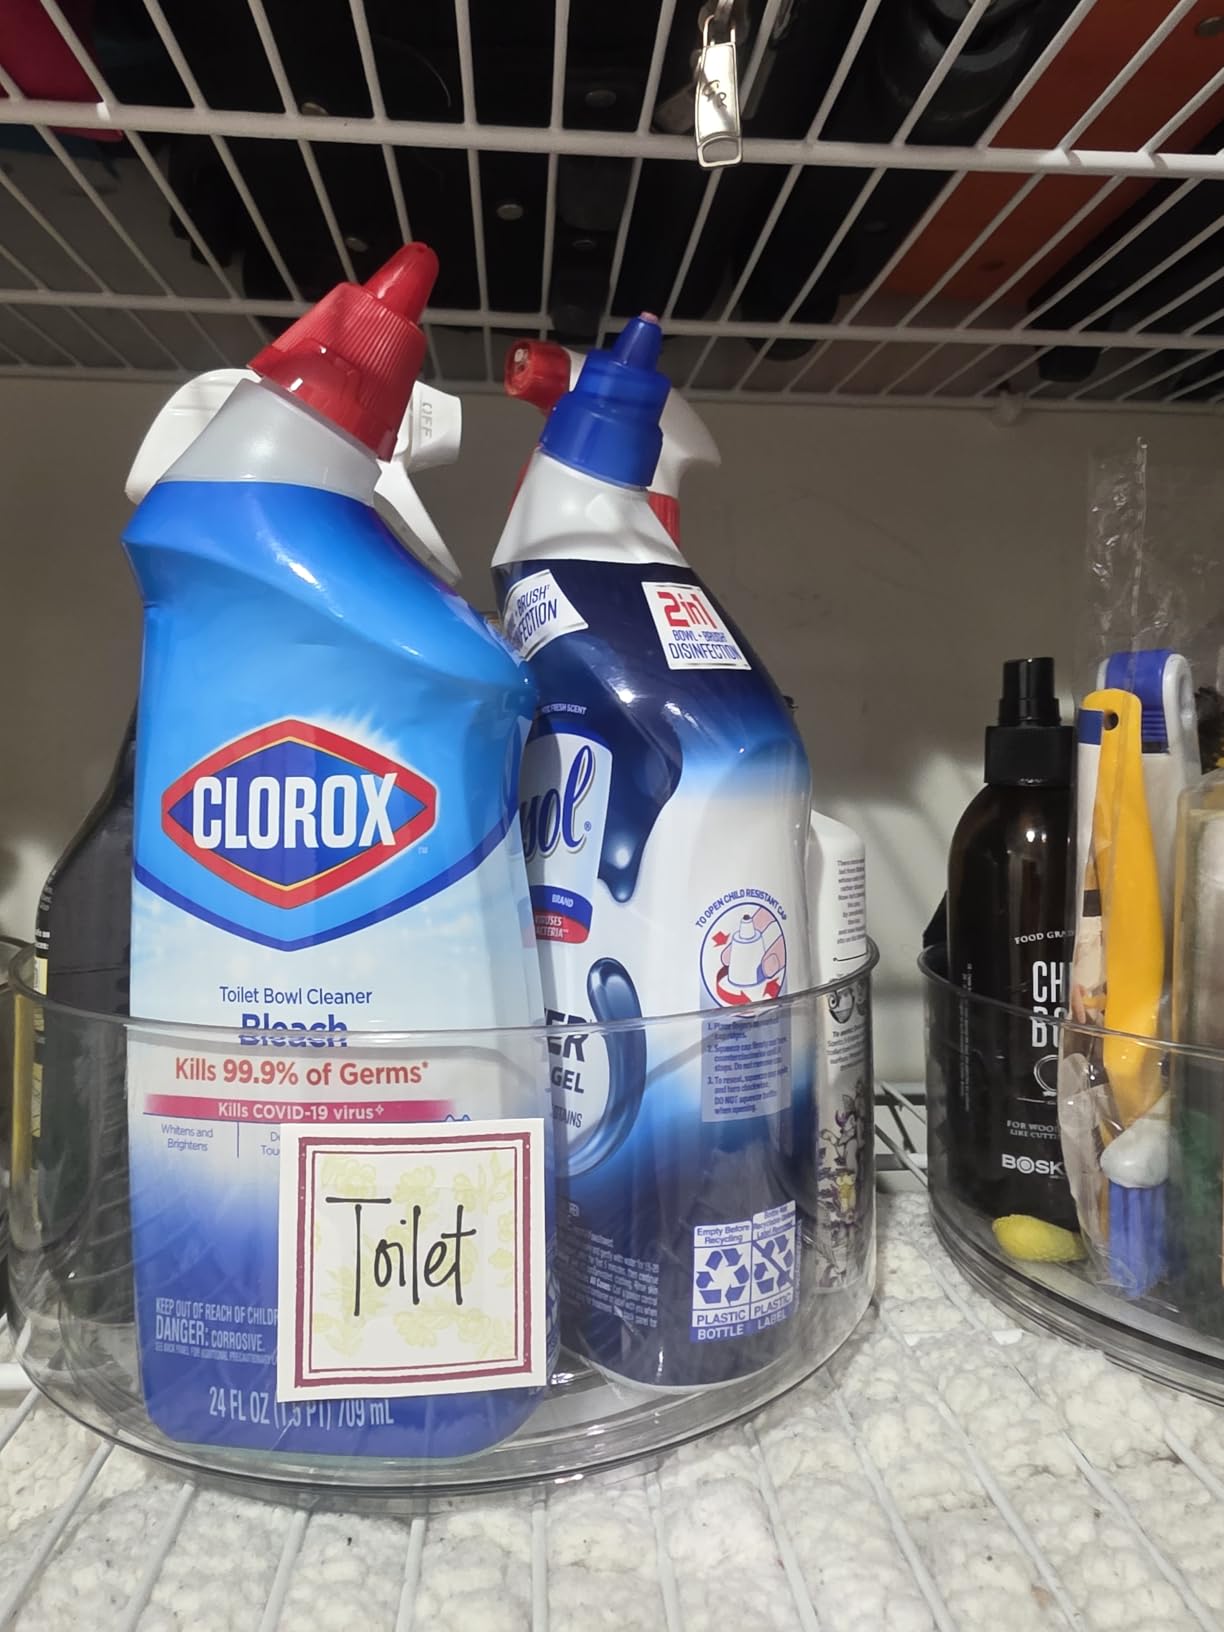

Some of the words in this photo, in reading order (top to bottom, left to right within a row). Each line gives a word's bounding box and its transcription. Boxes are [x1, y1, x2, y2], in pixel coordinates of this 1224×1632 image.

[421, 402, 433, 439] OFF
[671, 630, 698, 642] BOWL
[668, 643, 742, 661] DISINFECTION
[193, 772, 399, 849] CLOROX
[552, 893, 574, 908] BRAND
[695, 916, 707, 928] TO
[704, 898, 724, 919] OPEN
[723, 889, 745, 904] CHILD
[745, 888, 780, 909] RESISTANT
[1014, 932, 1044, 945] FOOD
[219, 986, 259, 1004] Toilet
[263, 987, 302, 1005] Bowl
[306, 988, 373, 1005] Cleaner
[239, 1013, 348, 1048] Bleach
[175, 1057, 217, 1081] Kills
[223, 1059, 298, 1086] 99.9%
[306, 1062, 332, 1085] of
[551, 1066, 585, 1094] GEL
[217, 1102, 249, 1118] Kills
[252, 1103, 328, 1121] COVID-19
[160, 1123, 195, 1137] Whitens
[195, 1128, 213, 1138] and
[1028, 1123, 1057, 1133] WOO
[167, 1138, 208, 1152] Brightens
[697, 1227, 723, 1237] Empty
[724, 1224, 750, 1235] Before
[704, 1234, 743, 1246] Recycling
[325, 1195, 477, 1317] Toilet
[155, 1297, 174, 1316] KEEP
[175, 1300, 192, 1319] OUT
[193, 1302, 204, 1320] OF
[205, 1303, 233, 1323] REACH
[234, 1306, 246, 1324] OF
[754, 1295, 791, 1317] PLASTIC
[697, 1310, 746, 1326] PLASTIC
[758, 1311, 787, 1330] LABEL
[156, 1314, 209, 1347] DANGER:
[211, 1330, 265, 1352] CORROSIVE.
[697, 1324, 744, 1341] BOTTLE
[209, 1386, 226, 1418] 24
[229, 1389, 246, 1422] FL
[249, 1391, 270, 1425] OZ
[369, 1399, 395, 1425] mL
